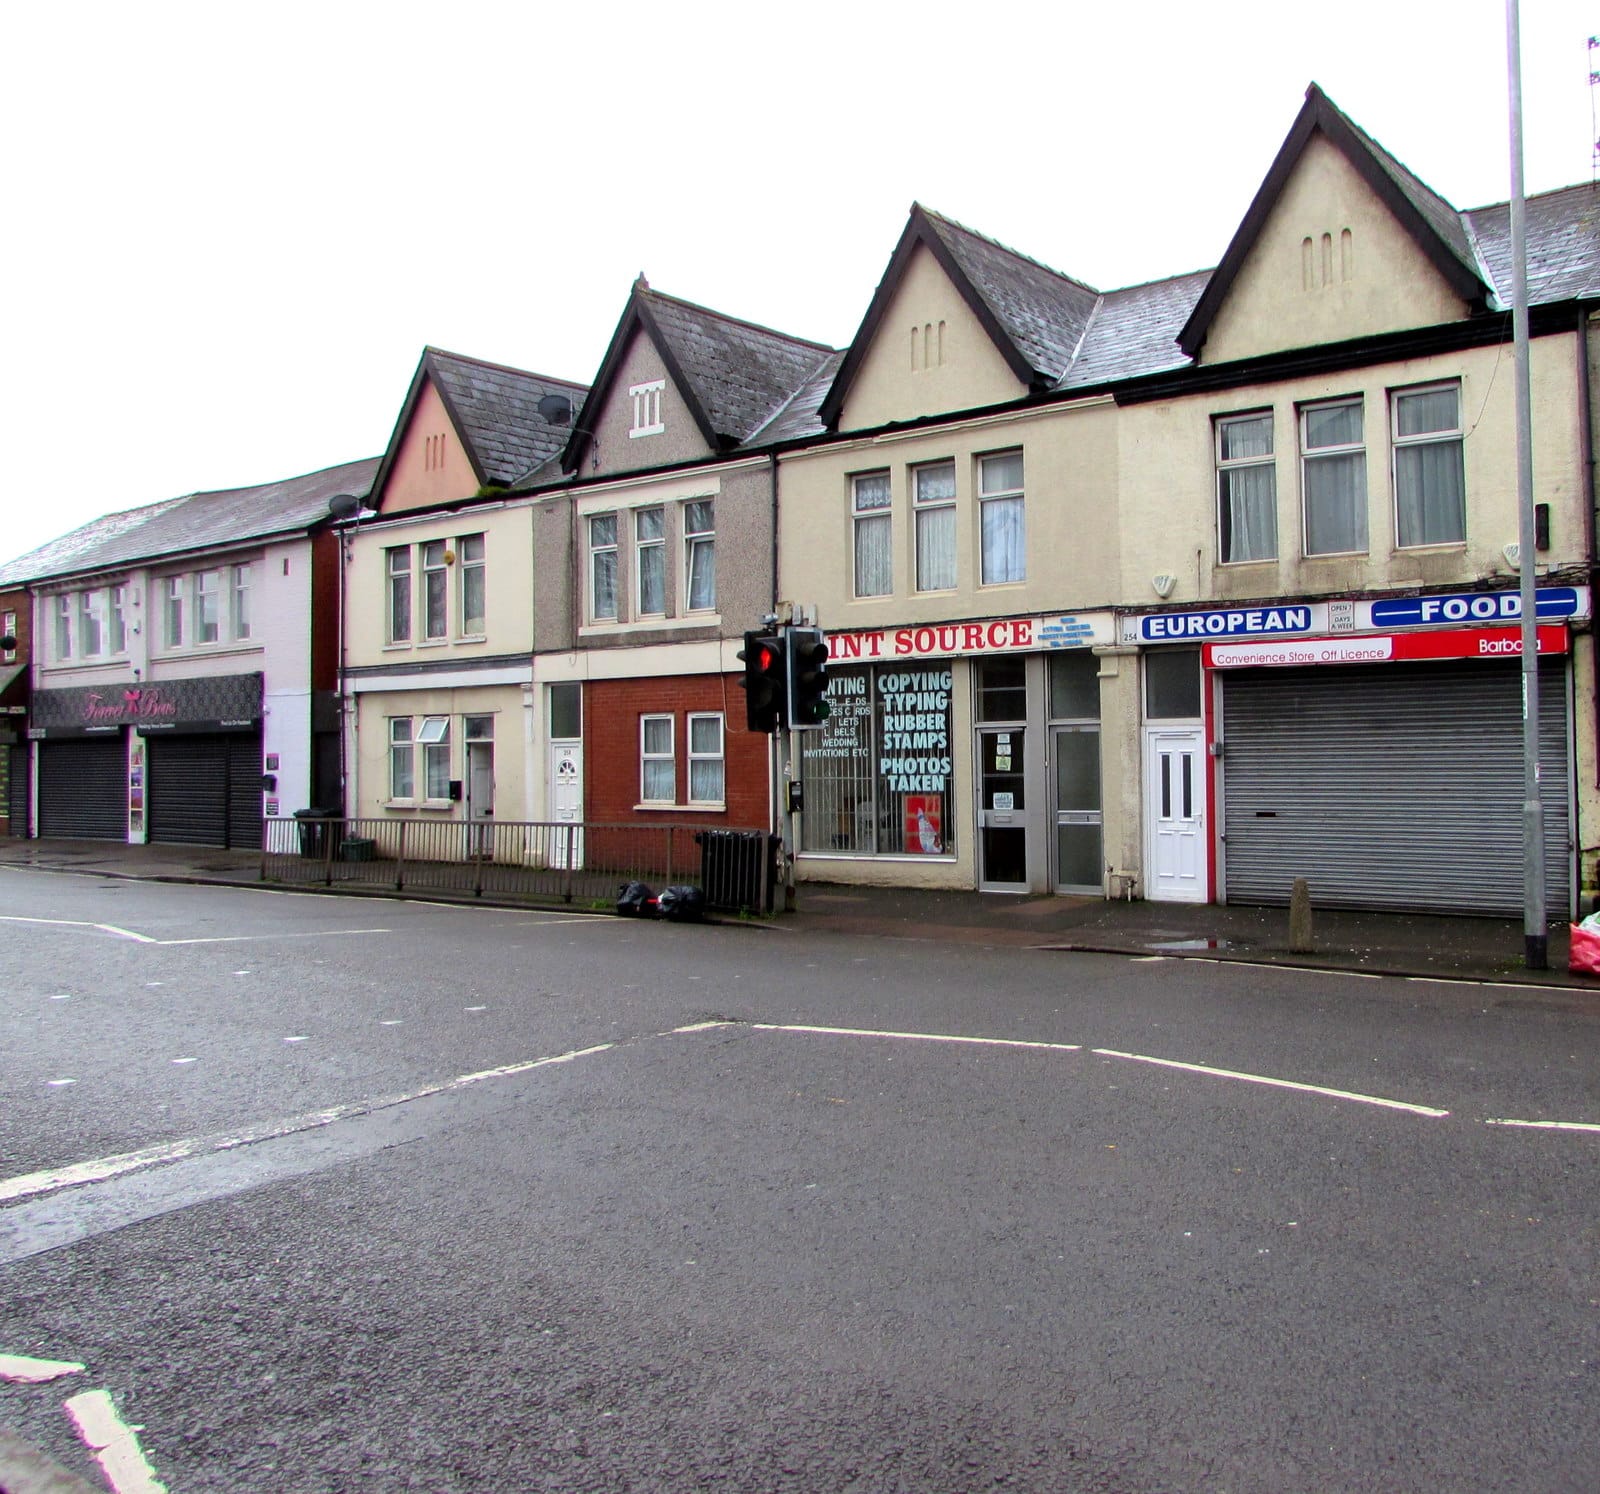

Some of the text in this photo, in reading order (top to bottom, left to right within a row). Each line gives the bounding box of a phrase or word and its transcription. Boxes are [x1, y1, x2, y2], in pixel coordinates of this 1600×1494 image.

[1421, 594, 1522, 621] FOOD
[1149, 609, 1306, 637] EUROPEAN
[828, 620, 1033, 659] INT SOURCE
[1124, 633, 1137, 641] 254
[1217, 648, 1384, 665] Convenience Store Off Licence
[826, 677, 866, 696] NTING
[878, 671, 953, 693] COPYING
[884, 691, 948, 712] TYPING
[884, 713, 946, 731] RUBBER
[822, 738, 859, 747] WEDDING
[884, 732, 947, 750] STAMPS
[803, 748, 869, 758] INVITATIONS ETC
[881, 757, 951, 774] PHOTOS
[888, 775, 944, 791] TAKEN
